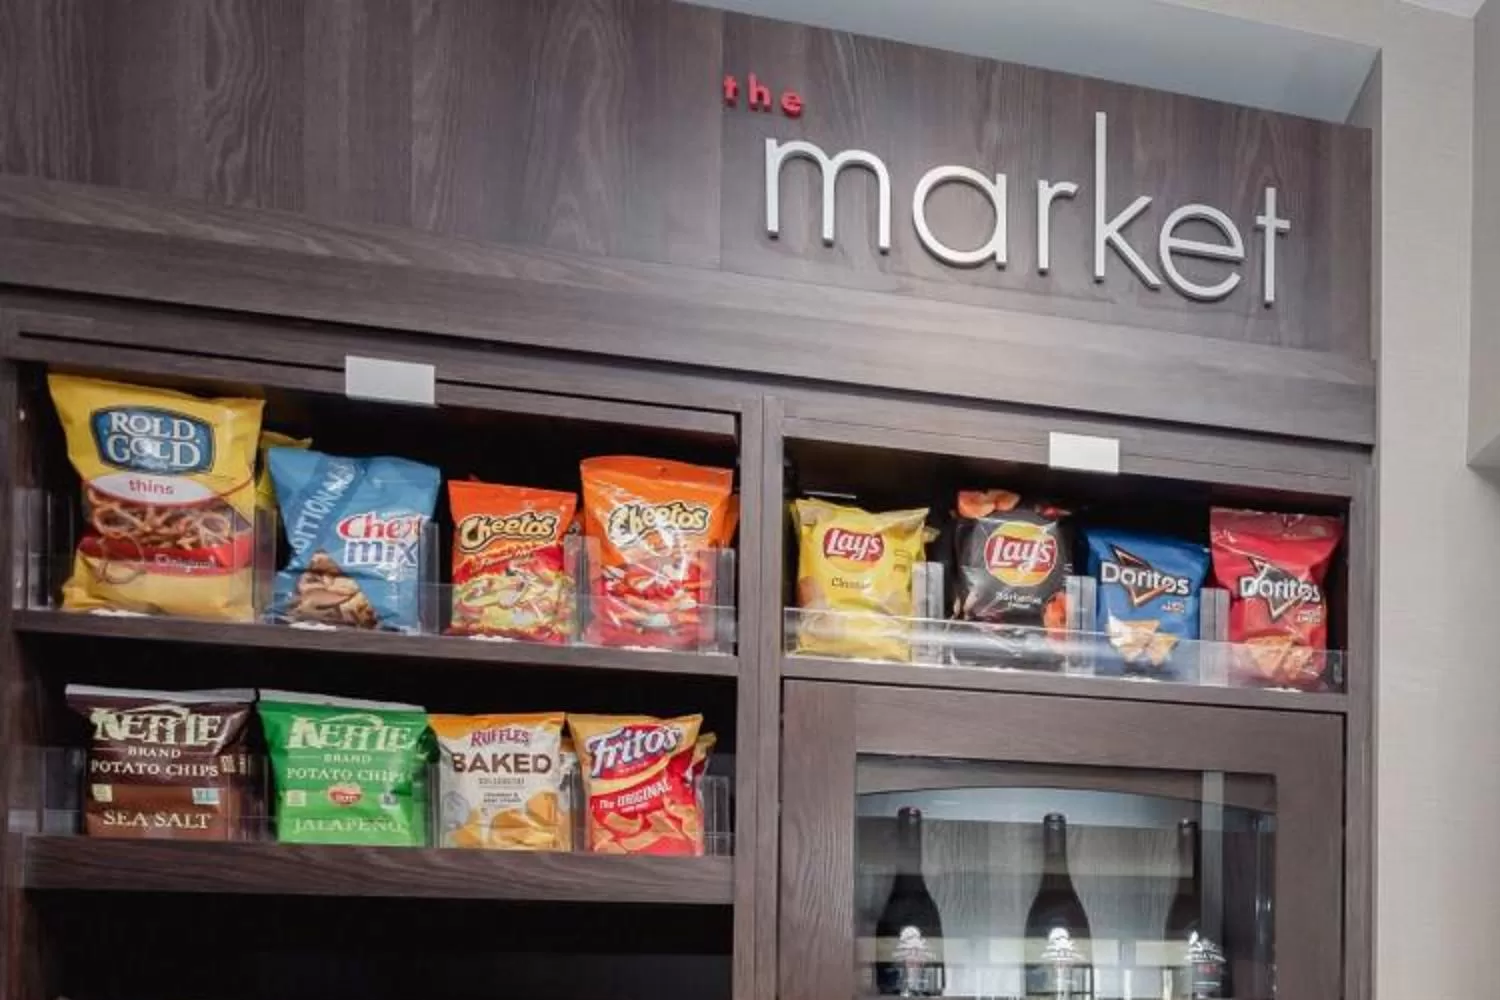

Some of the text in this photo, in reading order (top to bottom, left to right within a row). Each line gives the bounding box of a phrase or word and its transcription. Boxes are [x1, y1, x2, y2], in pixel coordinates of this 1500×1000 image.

[723, 73, 804, 117] the
[765, 111, 1291, 309] market
[109, 411, 194, 441] ROLD
[107, 435, 200, 468] GOLD
[128, 478, 175, 496] thins
[460, 514, 557, 550] Cheetos
[609, 502, 711, 541] Cheetos
[344, 541, 418, 569] mix
[826, 529, 882, 560] Lay's
[990, 537, 1052, 574] Lay's
[1101, 562, 1190, 595] Doritos
[1240, 576, 1320, 602] Doritos
[470, 727, 531, 747] RUFFLES
[127, 747, 182, 759] BRAND
[452, 752, 552, 774] BAKED
[91, 760, 219, 778] POTATO CHIPS
[286, 767, 353, 781] POTATO
[102, 811, 212, 829] SEA SALT
